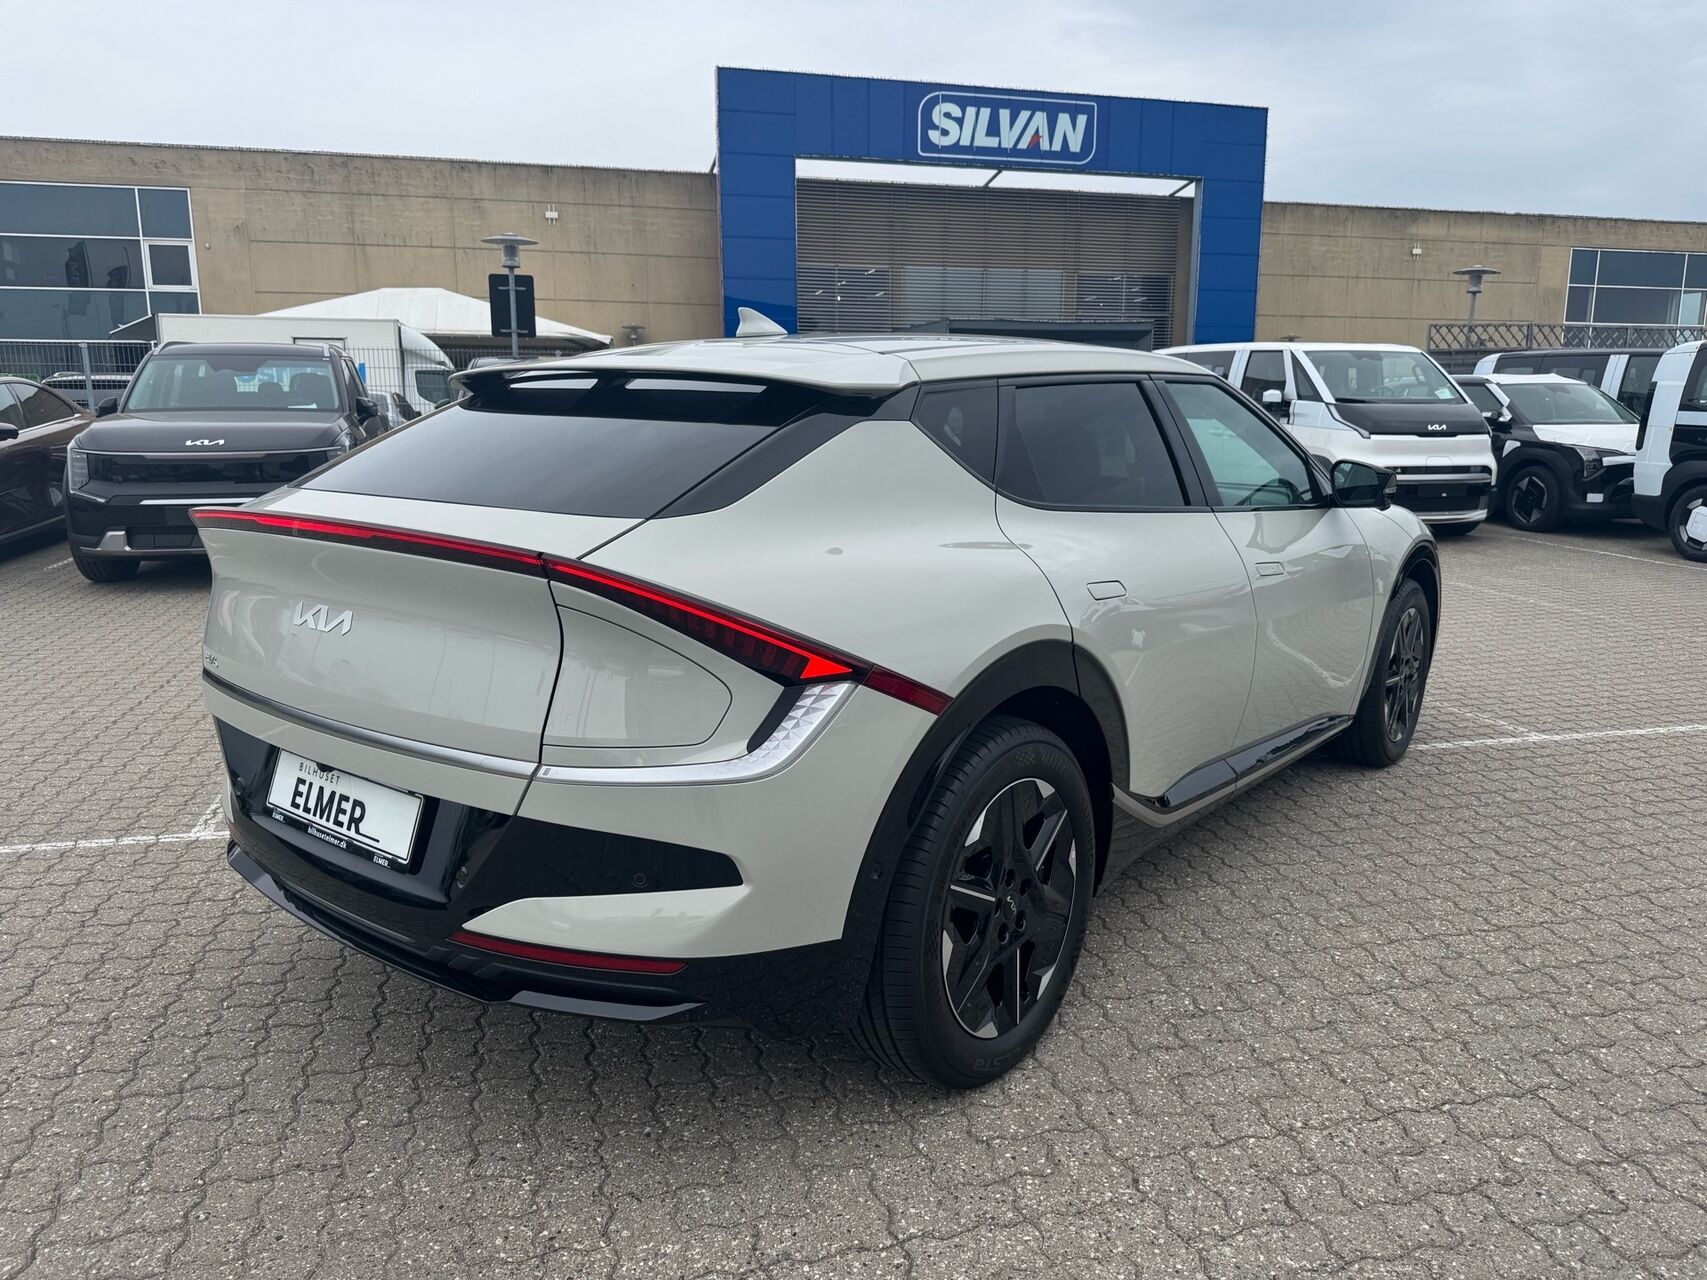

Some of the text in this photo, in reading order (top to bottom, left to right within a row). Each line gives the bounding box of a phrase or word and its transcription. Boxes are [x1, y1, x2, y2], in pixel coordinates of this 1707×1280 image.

[927, 102, 1088, 153] SILVAN
[293, 600, 353, 636] KIA
[298, 761, 341, 786] BILHUSET
[290, 776, 379, 843] ELMER
[373, 855, 389, 867] ELMER
